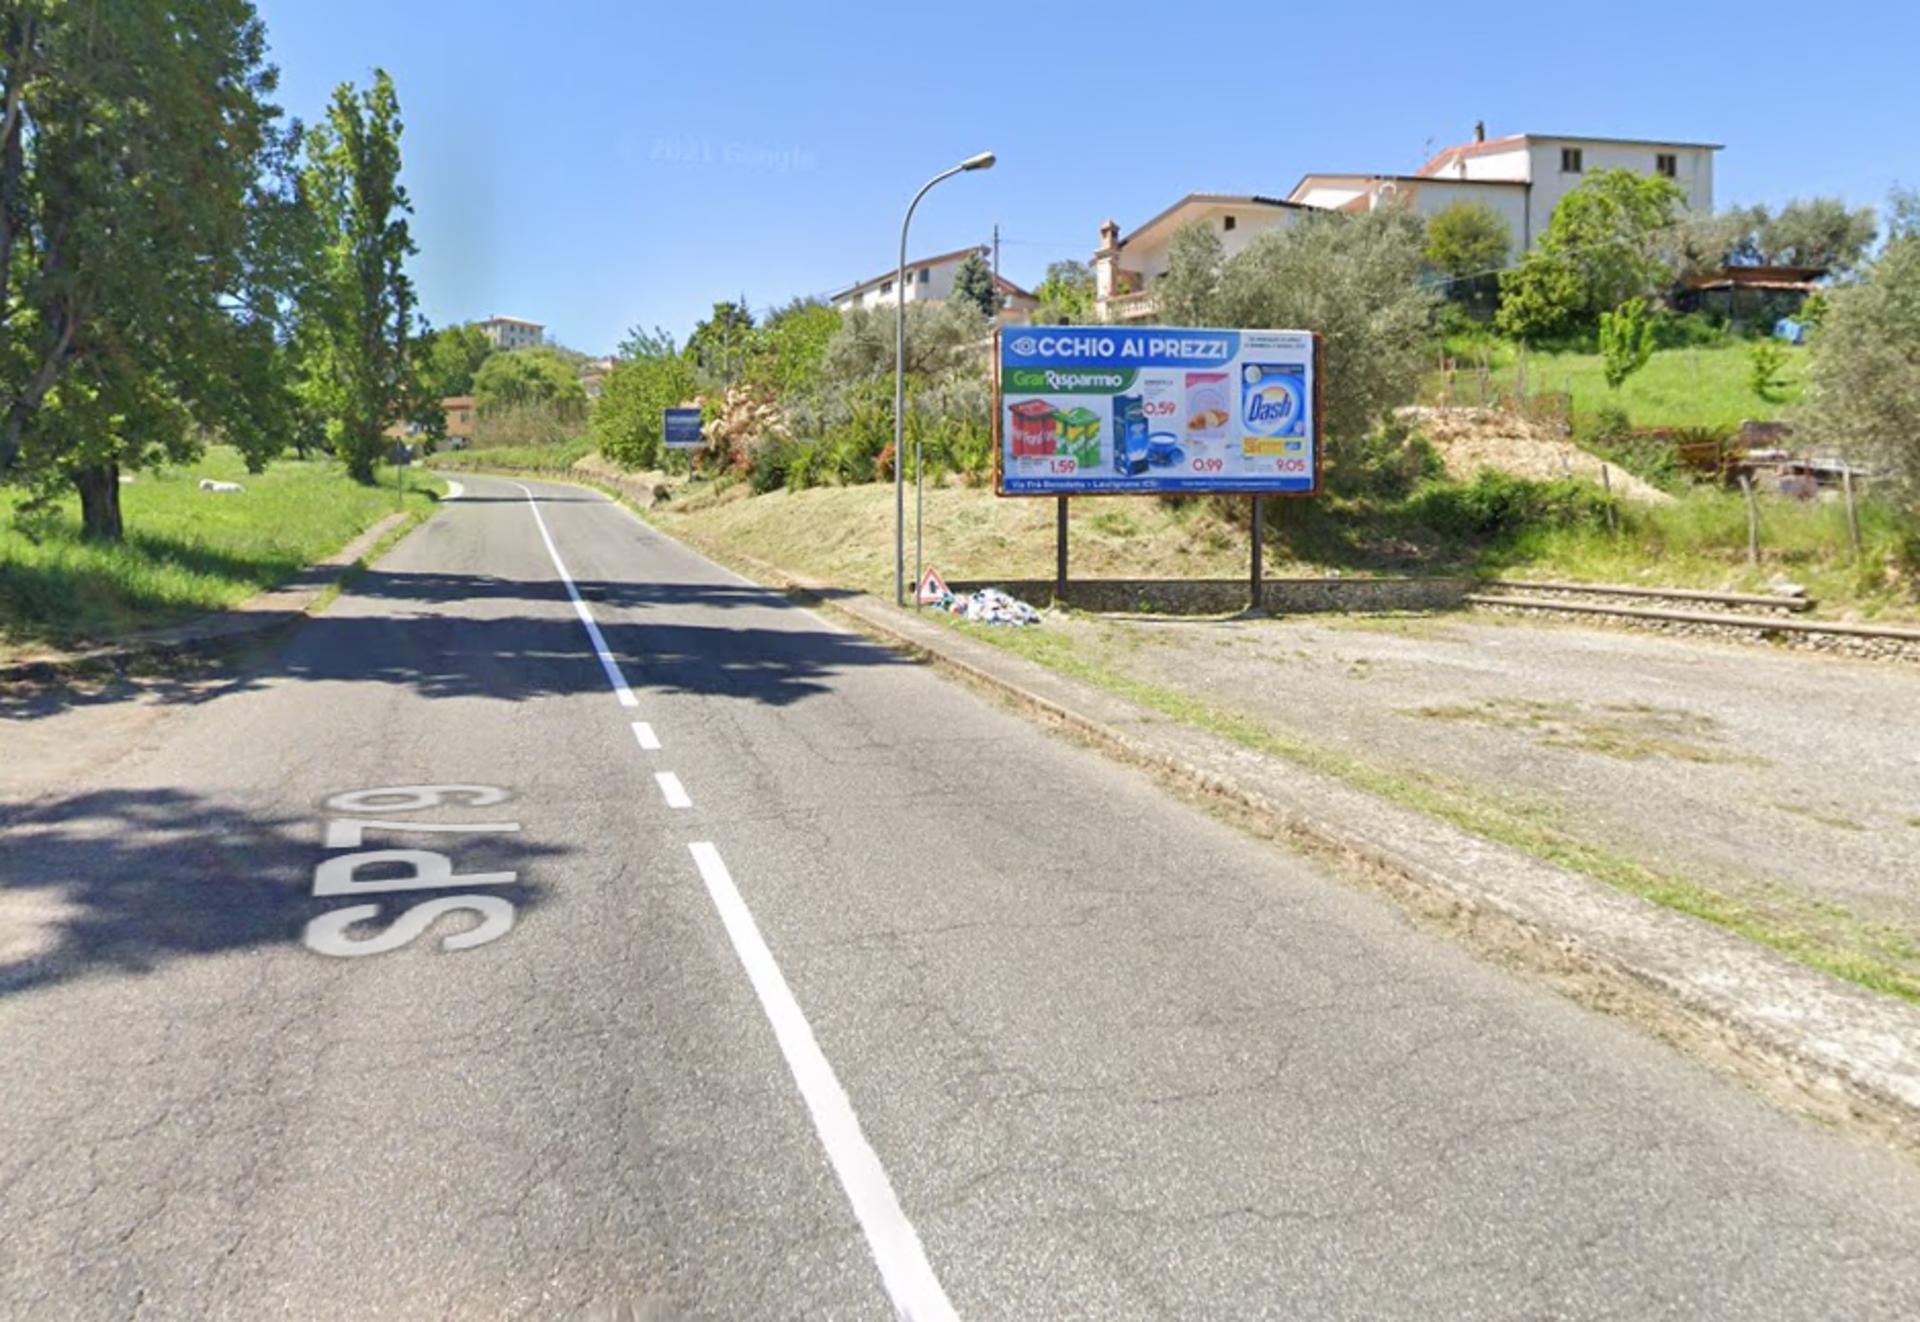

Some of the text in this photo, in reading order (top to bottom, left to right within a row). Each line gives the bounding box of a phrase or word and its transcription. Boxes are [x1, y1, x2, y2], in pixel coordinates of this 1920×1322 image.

[1120, 338, 1144, 357] AI
[1149, 339, 1228, 359] PREZZI
[1248, 393, 1293, 422] Dash
